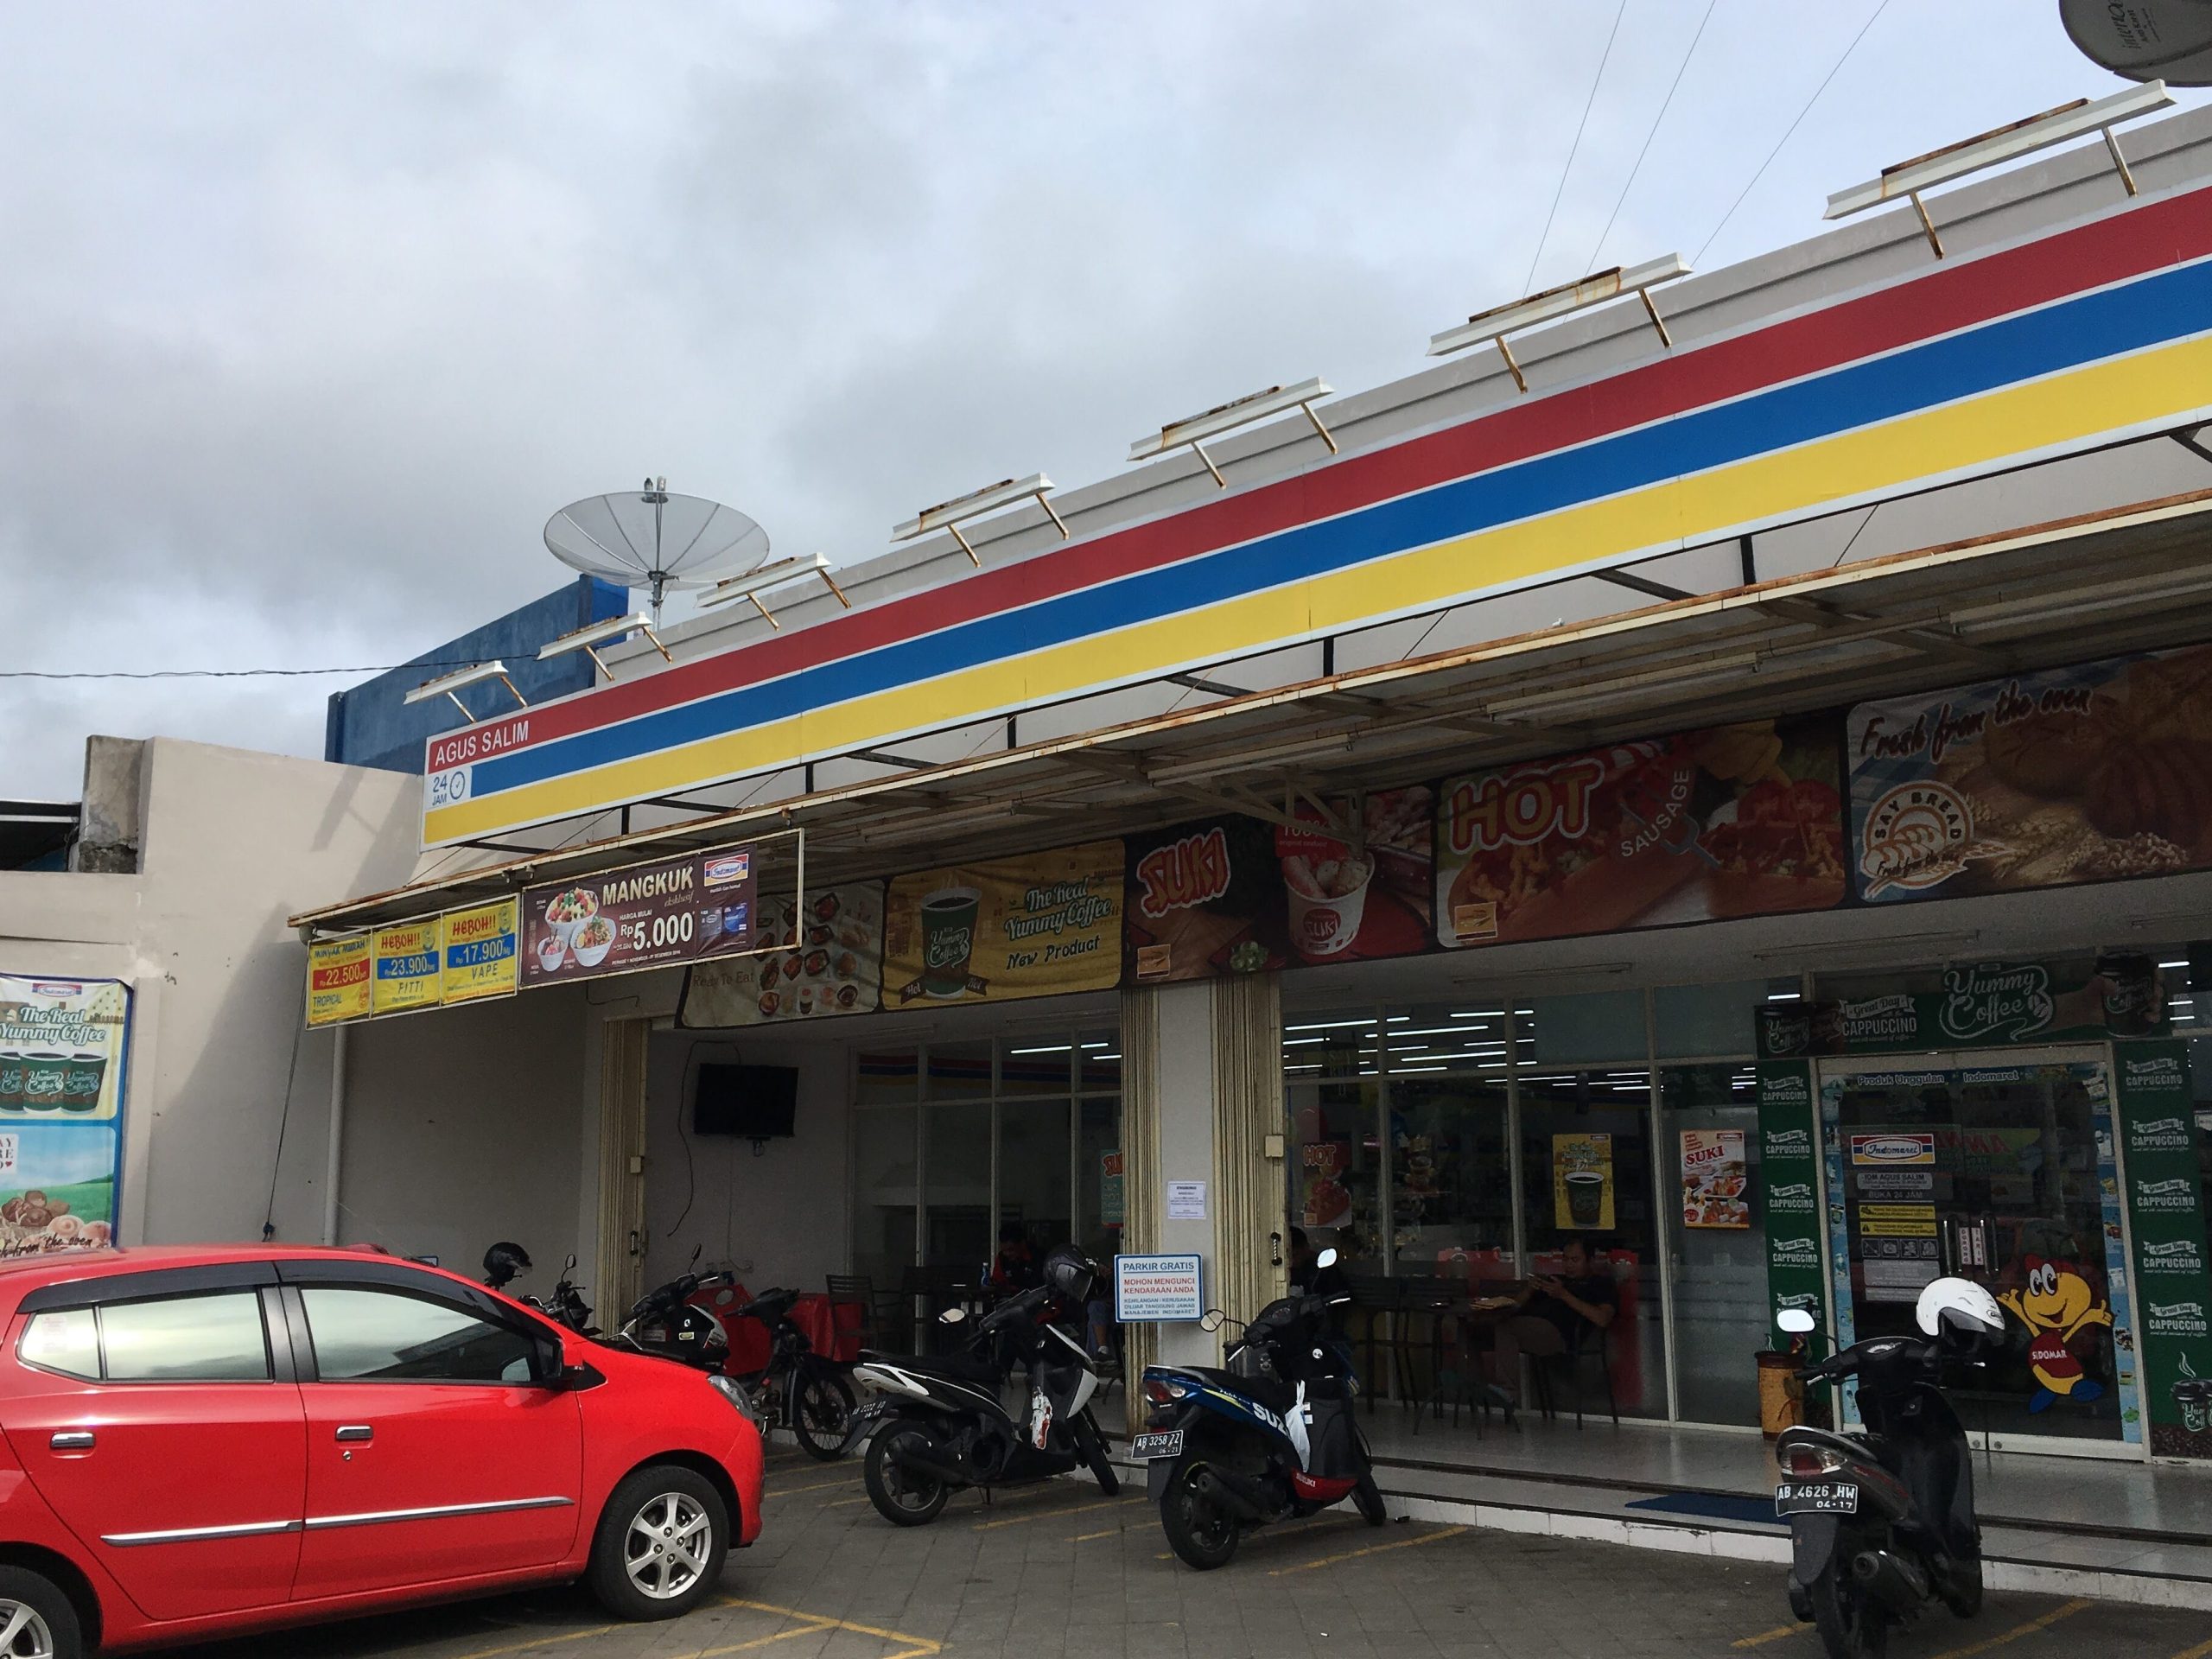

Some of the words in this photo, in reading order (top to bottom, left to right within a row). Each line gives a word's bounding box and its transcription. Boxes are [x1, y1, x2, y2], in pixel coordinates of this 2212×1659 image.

[1860, 713, 1926, 758] Fresh
[1931, 702, 1986, 764] from
[1994, 679, 2033, 726] the
[2039, 690, 2093, 715] oven
[435, 735, 476, 766] AGUS
[482, 720, 529, 753] SALIM
[433, 774, 448, 792] 24
[432, 793, 448, 805] JAM
[1452, 760, 1603, 853] HOT
[1620, 770, 1690, 857] SAUSAGE
[1874, 800, 1899, 838] SAY
[1910, 791, 1962, 839] BREAD
[1138, 829, 1229, 916] SUKI
[602, 866, 693, 906] MANGKUK
[1026, 887, 1052, 911] The
[1052, 878, 1089, 905] Real
[1005, 911, 1065, 940] Yummy
[1067, 897, 1112, 928] Coffee
[620, 924, 633, 938] Rp
[633, 912, 693, 950] 5.000
[1006, 952, 1038, 970] New
[1044, 935, 1101, 963] Product
[326, 963, 360, 986] 22.500
[391, 956, 428, 976] 23.900
[472, 963, 498, 980] VAPE
[397, 981, 423, 994] FITTI
[1945, 969, 2036, 995] Yummy
[21, 1007, 48, 1023] The
[49, 1007, 85, 1024] Real
[1853, 1001, 1878, 1016] Great
[1880, 996, 1901, 1009] Day
[1948, 994, 2025, 1030] Coffee
[0, 1023, 60, 1045] Yummy
[60, 1025, 105, 1046] Coffee
[1842, 1017, 1917, 1037] CAPPUCCINO
[1858, 1075, 1893, 1085] Produk
[1895, 1072, 1944, 1087] Unggulan
[1963, 1070, 2019, 1083] Indomaret
[2126, 1074, 2183, 1086] CAPPUCCINO
[1867, 1144, 1918, 1154] Indomaret
[2132, 1135, 2189, 1146] CAPPUCCINO
[1304, 1145, 1335, 1166] HOT
[1686, 1146, 1724, 1165] SUKI
[1770, 1198, 1814, 1208] CAPPUCCINO
[2137, 1196, 2195, 1207] CAPPUCCINO
[1123, 1262, 1158, 1271] PARKIR
[1160, 1262, 1194, 1270] GRATIS
[1773, 1253, 1818, 1263] CAPPUCCINO
[2143, 1257, 2201, 1268] CAPPUCCINO
[2149, 1319, 2207, 1332] CAPPUCCINO
[1252, 1402, 1288, 1437] SUZ
[1137, 1437, 1147, 1448] AB
[1149, 1435, 1168, 1446] 3258
[1169, 1433, 1180, 1445] ZZ
[1777, 1485, 1791, 1501] AB
[1797, 1484, 1829, 1498] 4626
[1837, 1485, 1855, 1499] HW
